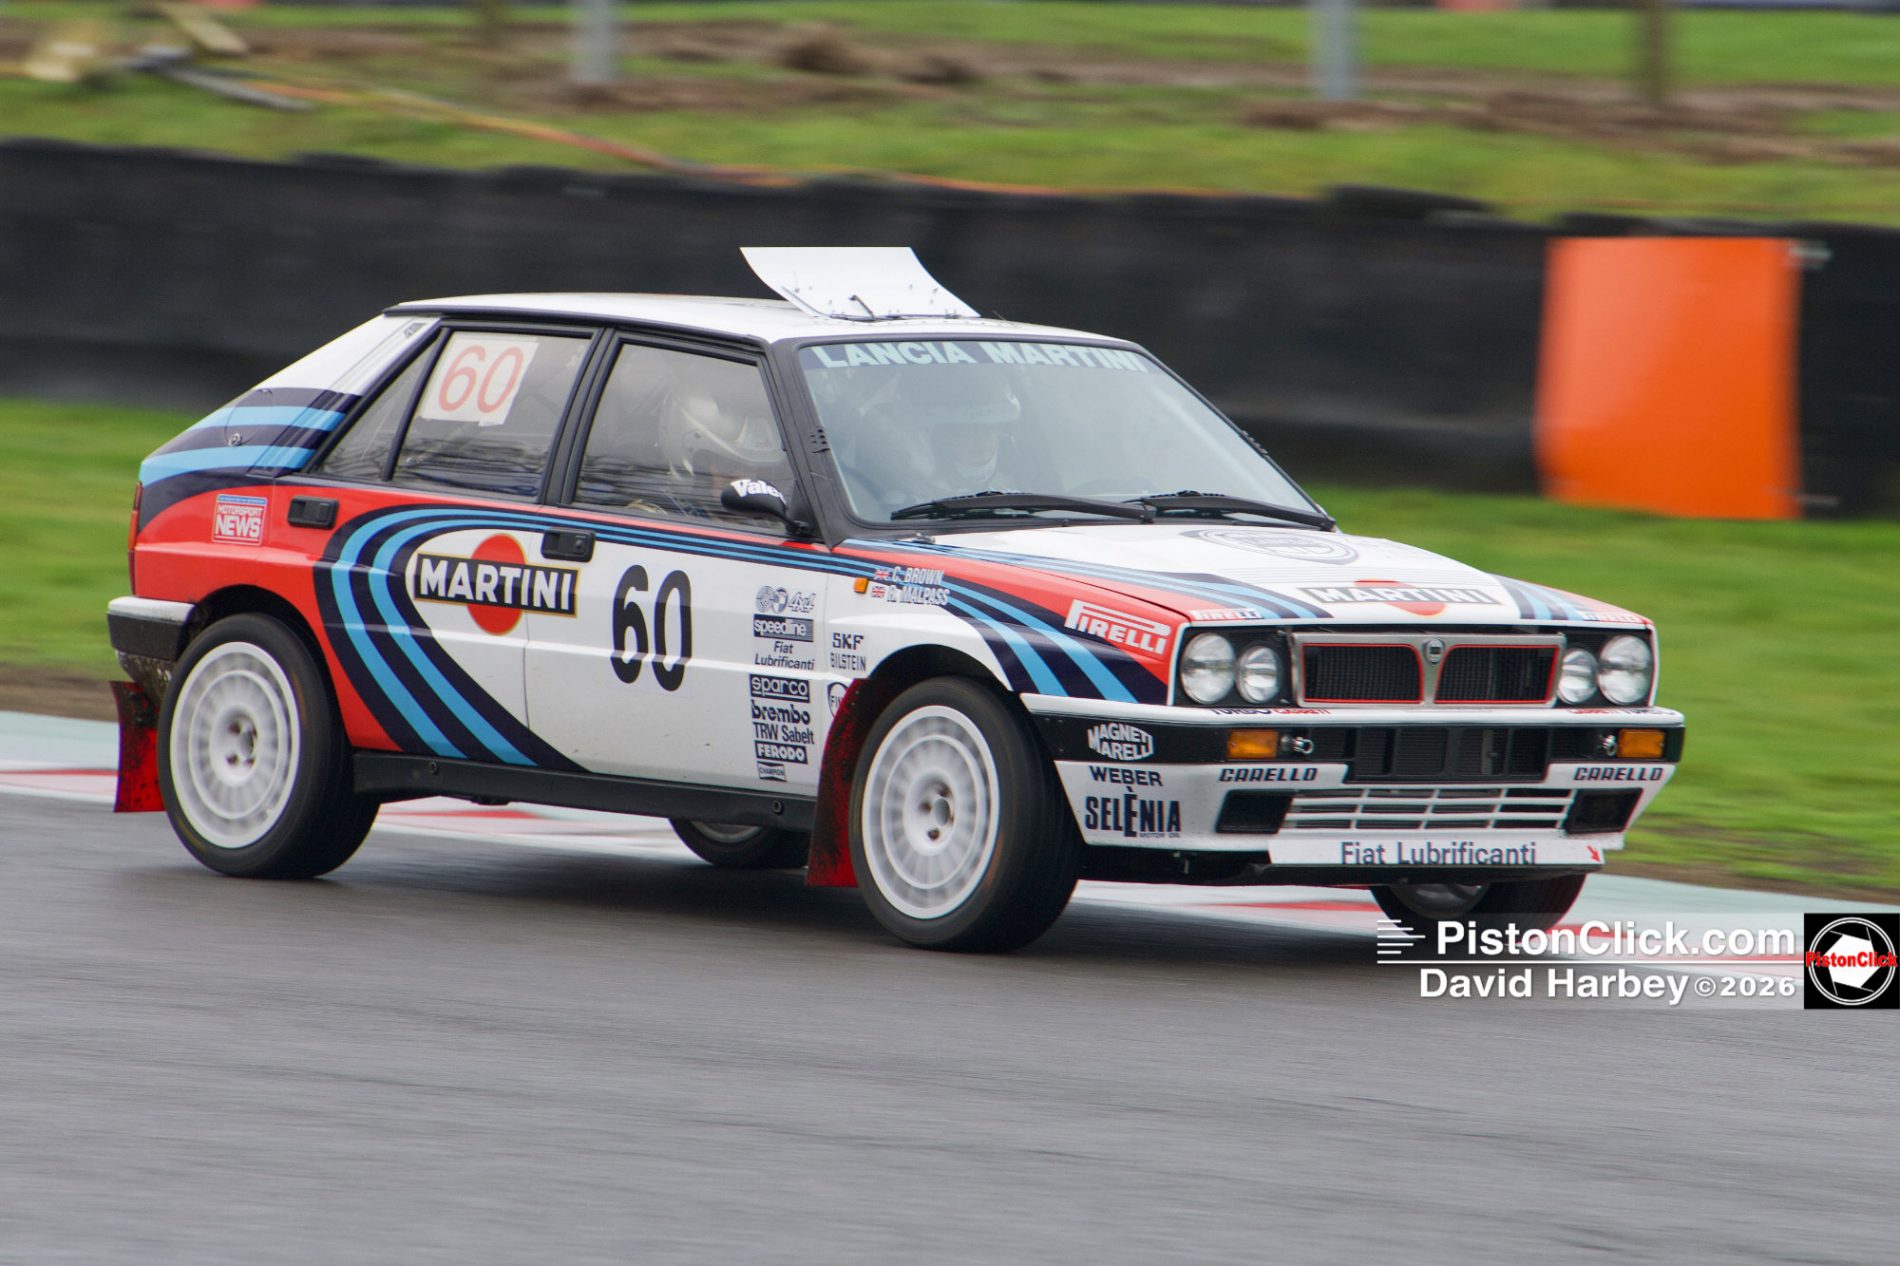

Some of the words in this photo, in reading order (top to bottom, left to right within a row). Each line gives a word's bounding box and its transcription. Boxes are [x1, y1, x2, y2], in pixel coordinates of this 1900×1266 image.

[811, 341, 976, 369] LANCIA
[977, 342, 1149, 373] MARTINI
[438, 345, 524, 414] 60
[215, 514, 261, 538] NEWS
[420, 558, 572, 610] MARTINI
[904, 567, 944, 585] BROWN
[788, 592, 816, 613] 4x4
[900, 585, 950, 606] MALPASS
[1310, 588, 1490, 602] MARTINI
[610, 565, 692, 692] 60
[753, 619, 807, 637] speedline
[1064, 599, 1172, 655] PIRELLI
[773, 640, 793, 654] Fiat
[832, 632, 864, 651] SKF
[754, 653, 815, 671] Lubrificanti
[830, 652, 866, 672] BILSTEIN
[751, 676, 808, 697] sparco
[751, 699, 811, 725] brembo
[752, 721, 779, 741] TRW
[781, 724, 815, 745] Sabelt
[758, 742, 806, 763] FERODO
[1089, 765, 1164, 787] WEBER
[1218, 768, 1318, 782] CARELLO
[1574, 767, 1663, 781] CARELLO
[1341, 841, 1386, 865] Fiat
[1397, 841, 1536, 865] Lubrificanti
